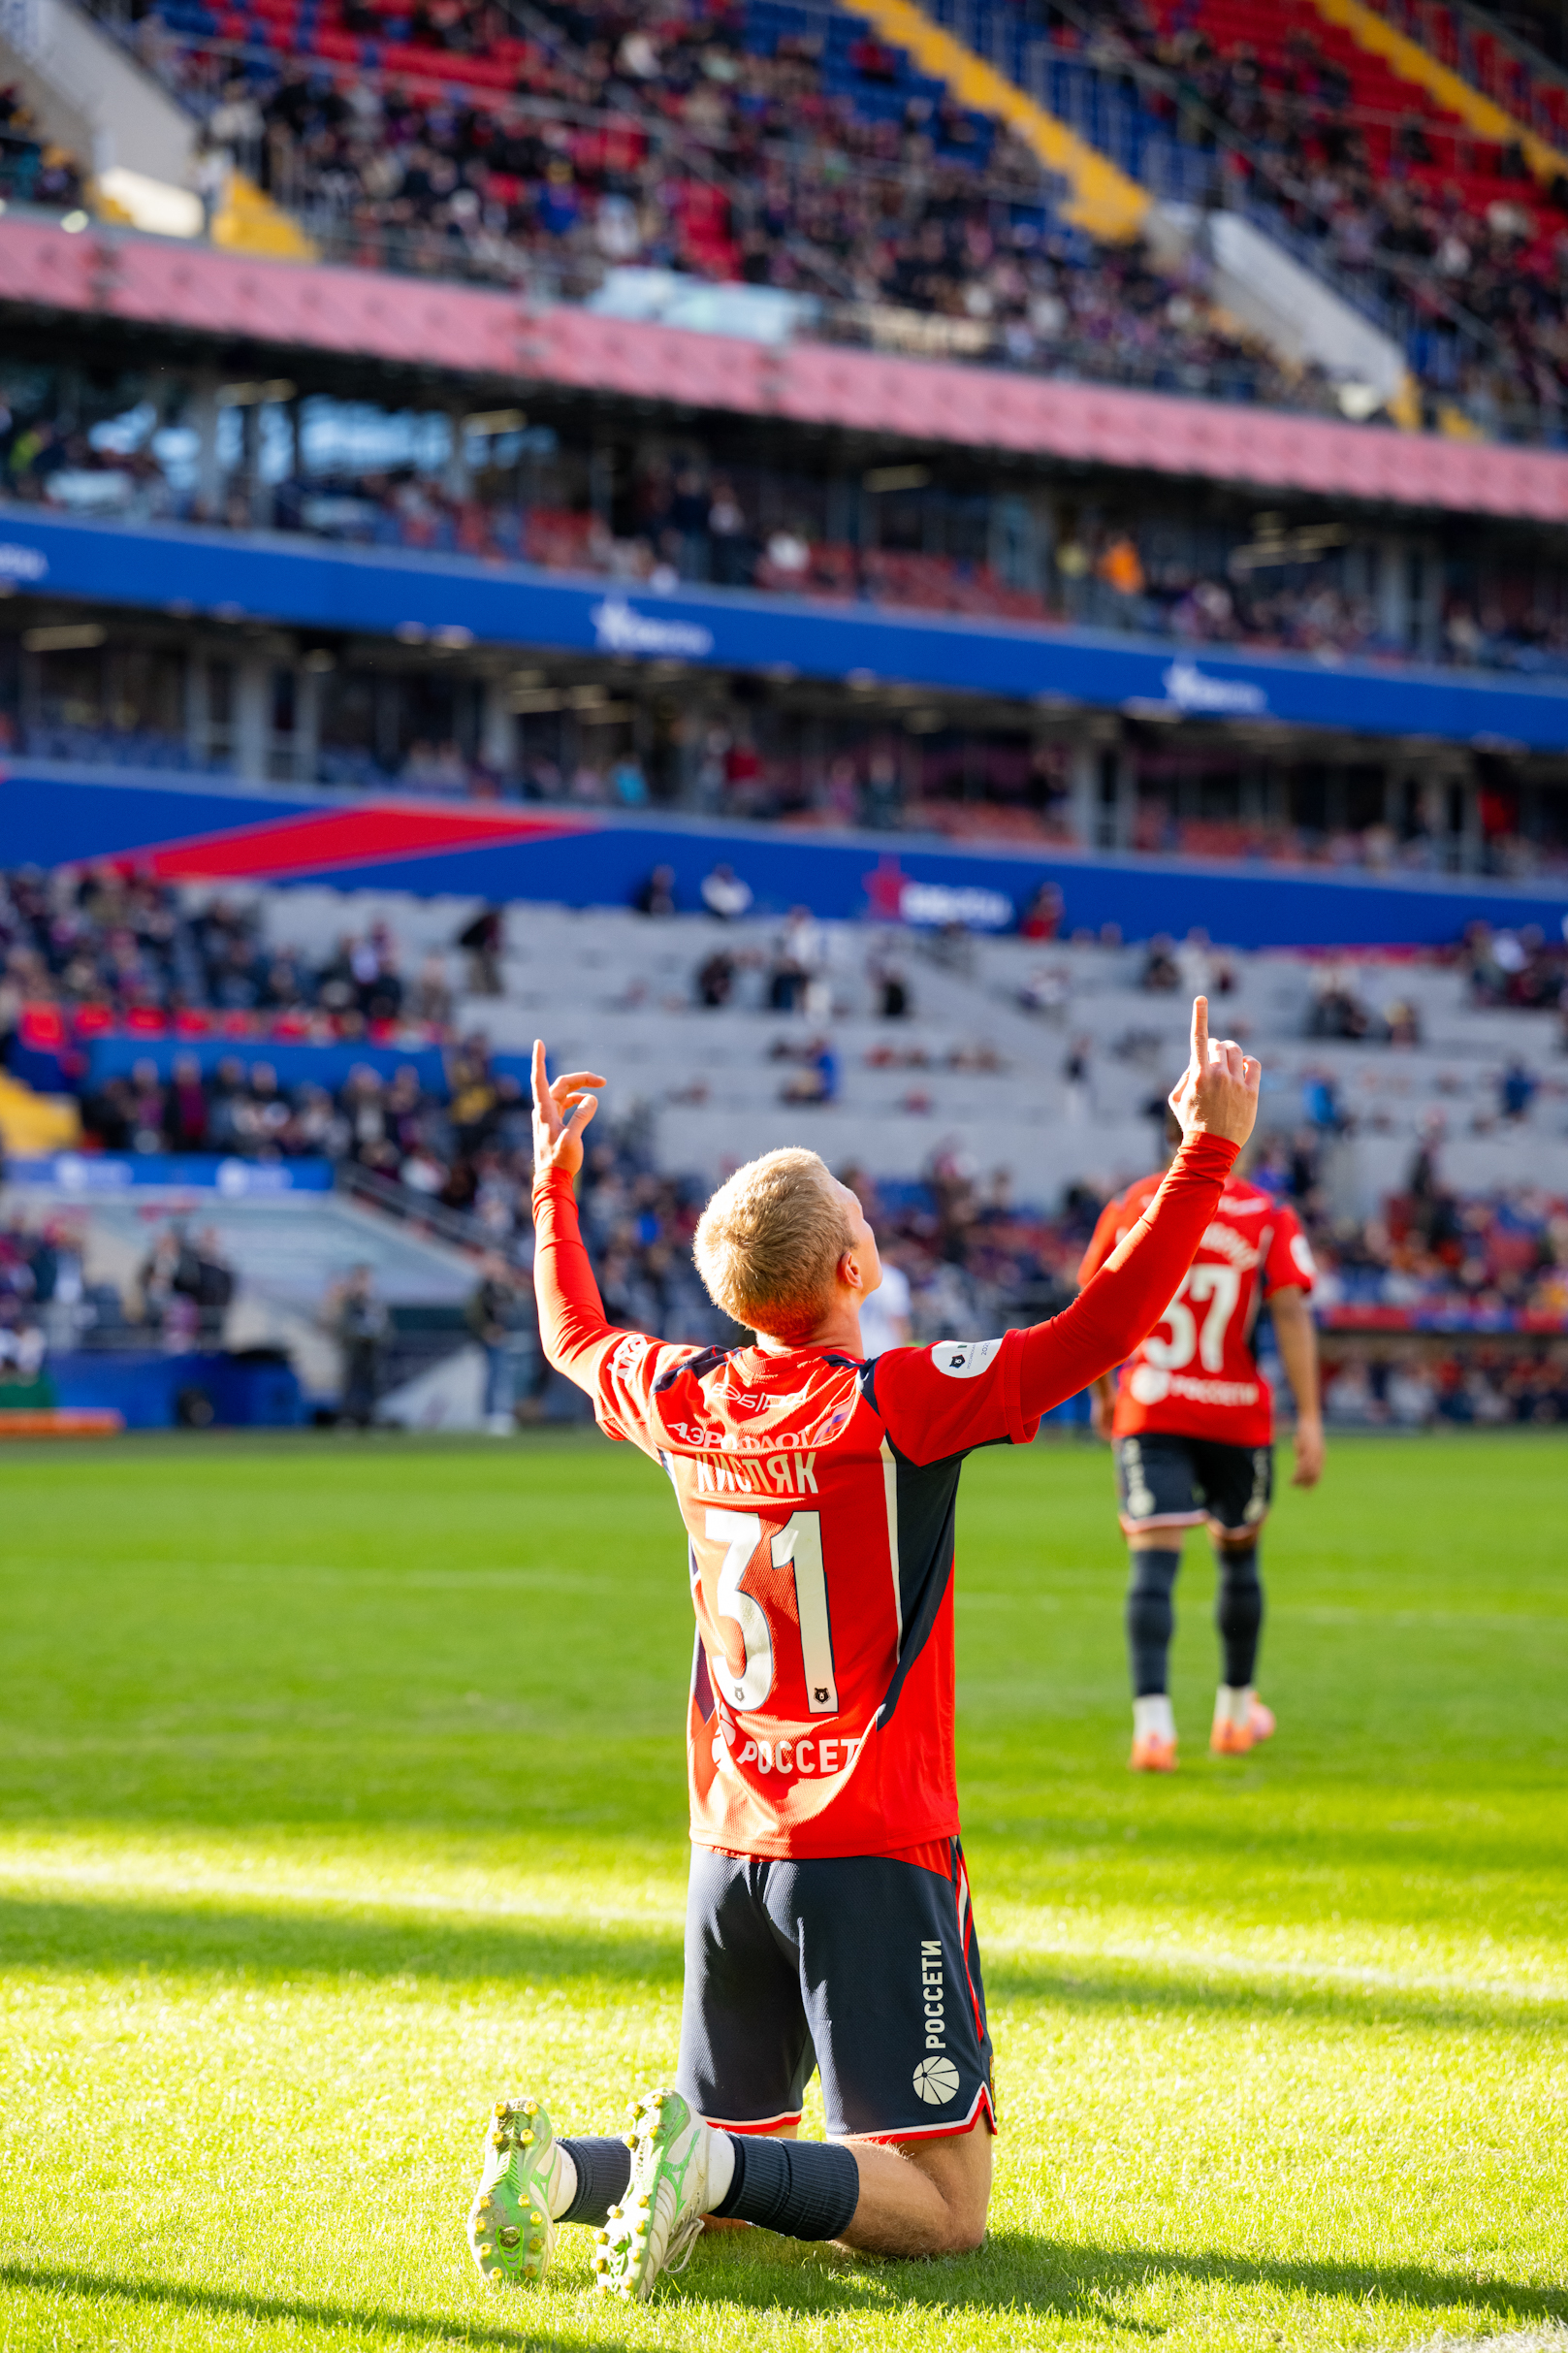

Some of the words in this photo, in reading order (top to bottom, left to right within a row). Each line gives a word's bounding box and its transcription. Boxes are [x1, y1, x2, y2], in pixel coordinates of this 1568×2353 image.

[696, 1452, 818, 1494] КИСЛЯК
[705, 1509, 839, 1714] 31
[736, 1738, 861, 1774] РОССЕТ
[921, 1941, 946, 2048] РОССЕТИ
